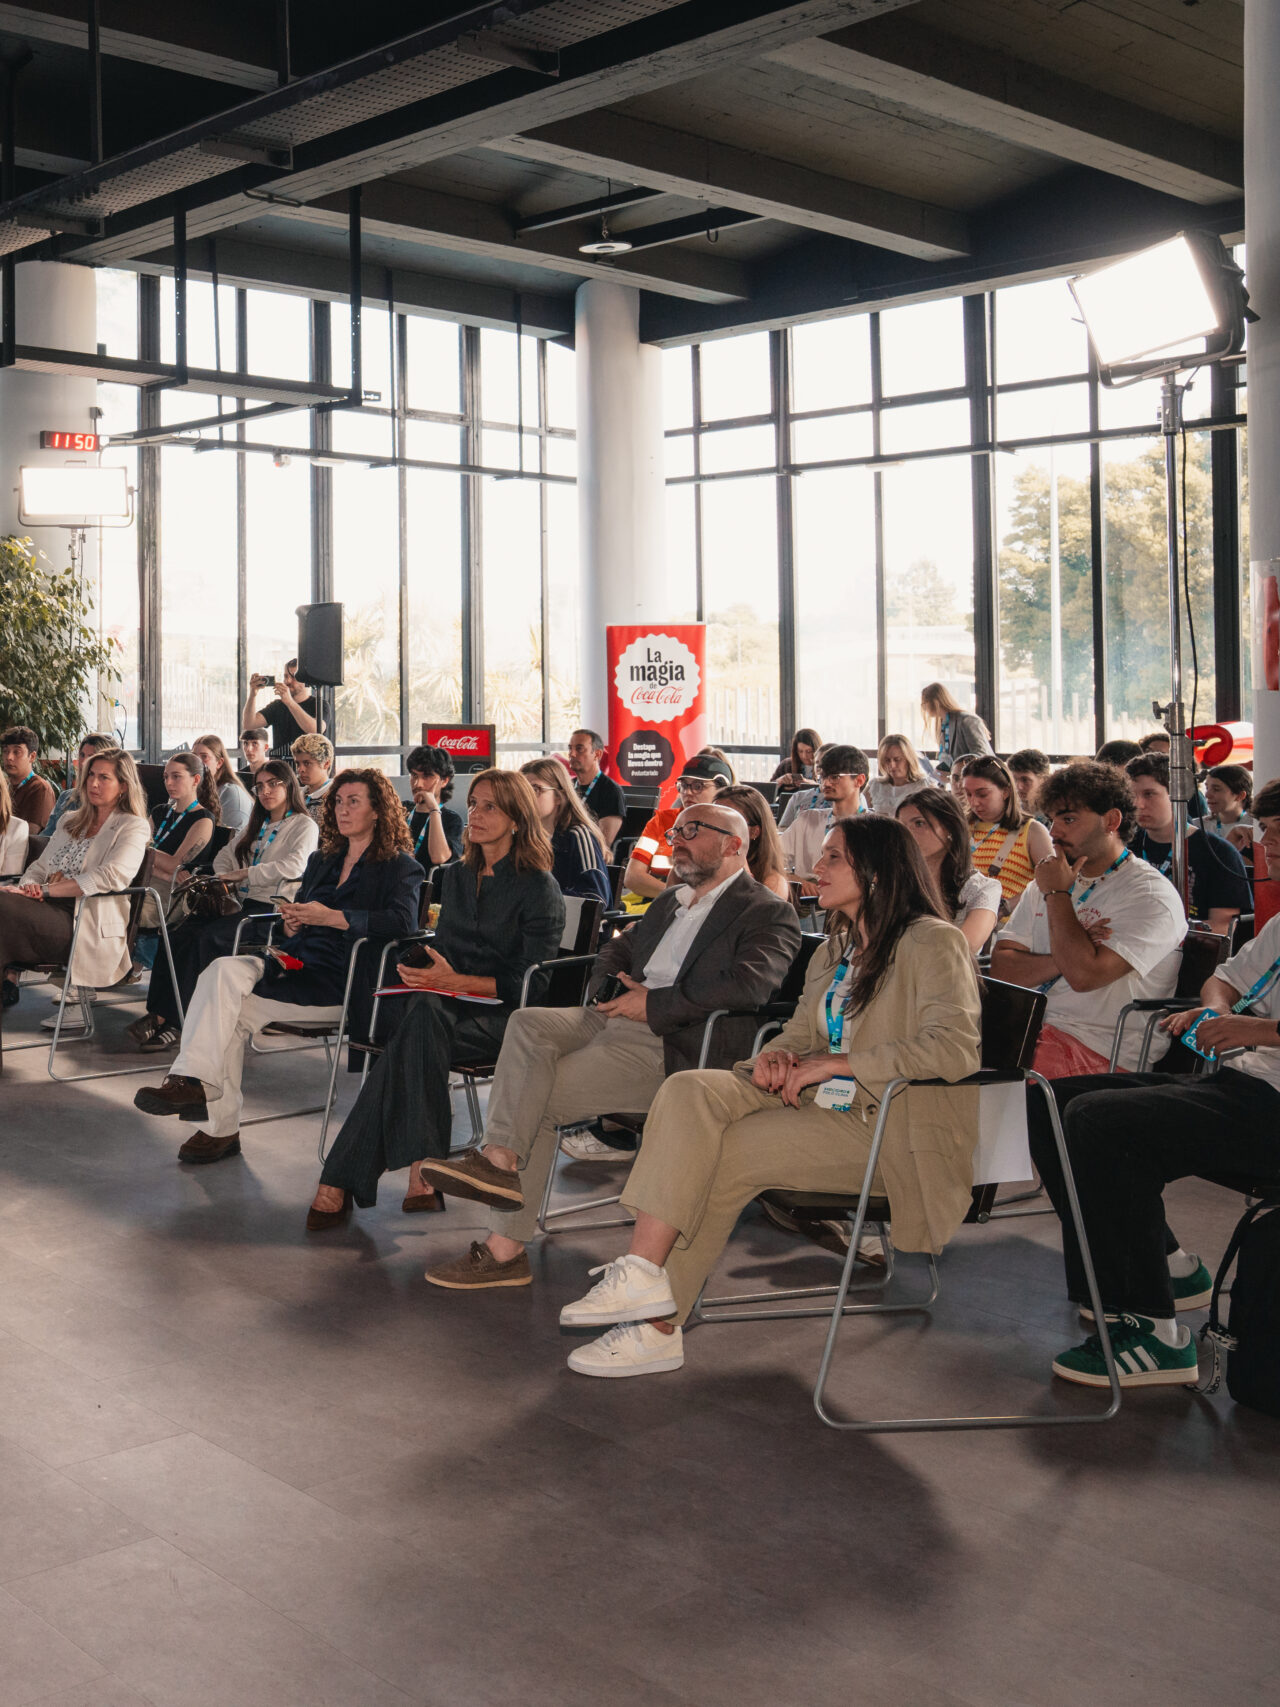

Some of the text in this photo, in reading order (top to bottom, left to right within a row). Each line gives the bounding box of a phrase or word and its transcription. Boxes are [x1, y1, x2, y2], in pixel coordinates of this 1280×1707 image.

[647, 648, 662, 663] La
[630, 661, 685, 686] magia
[649, 682, 658, 690] de
[631, 686, 684, 704] Coca-Cola
[632, 743, 656, 752] Destapa
[628, 751, 661, 760] la magia que
